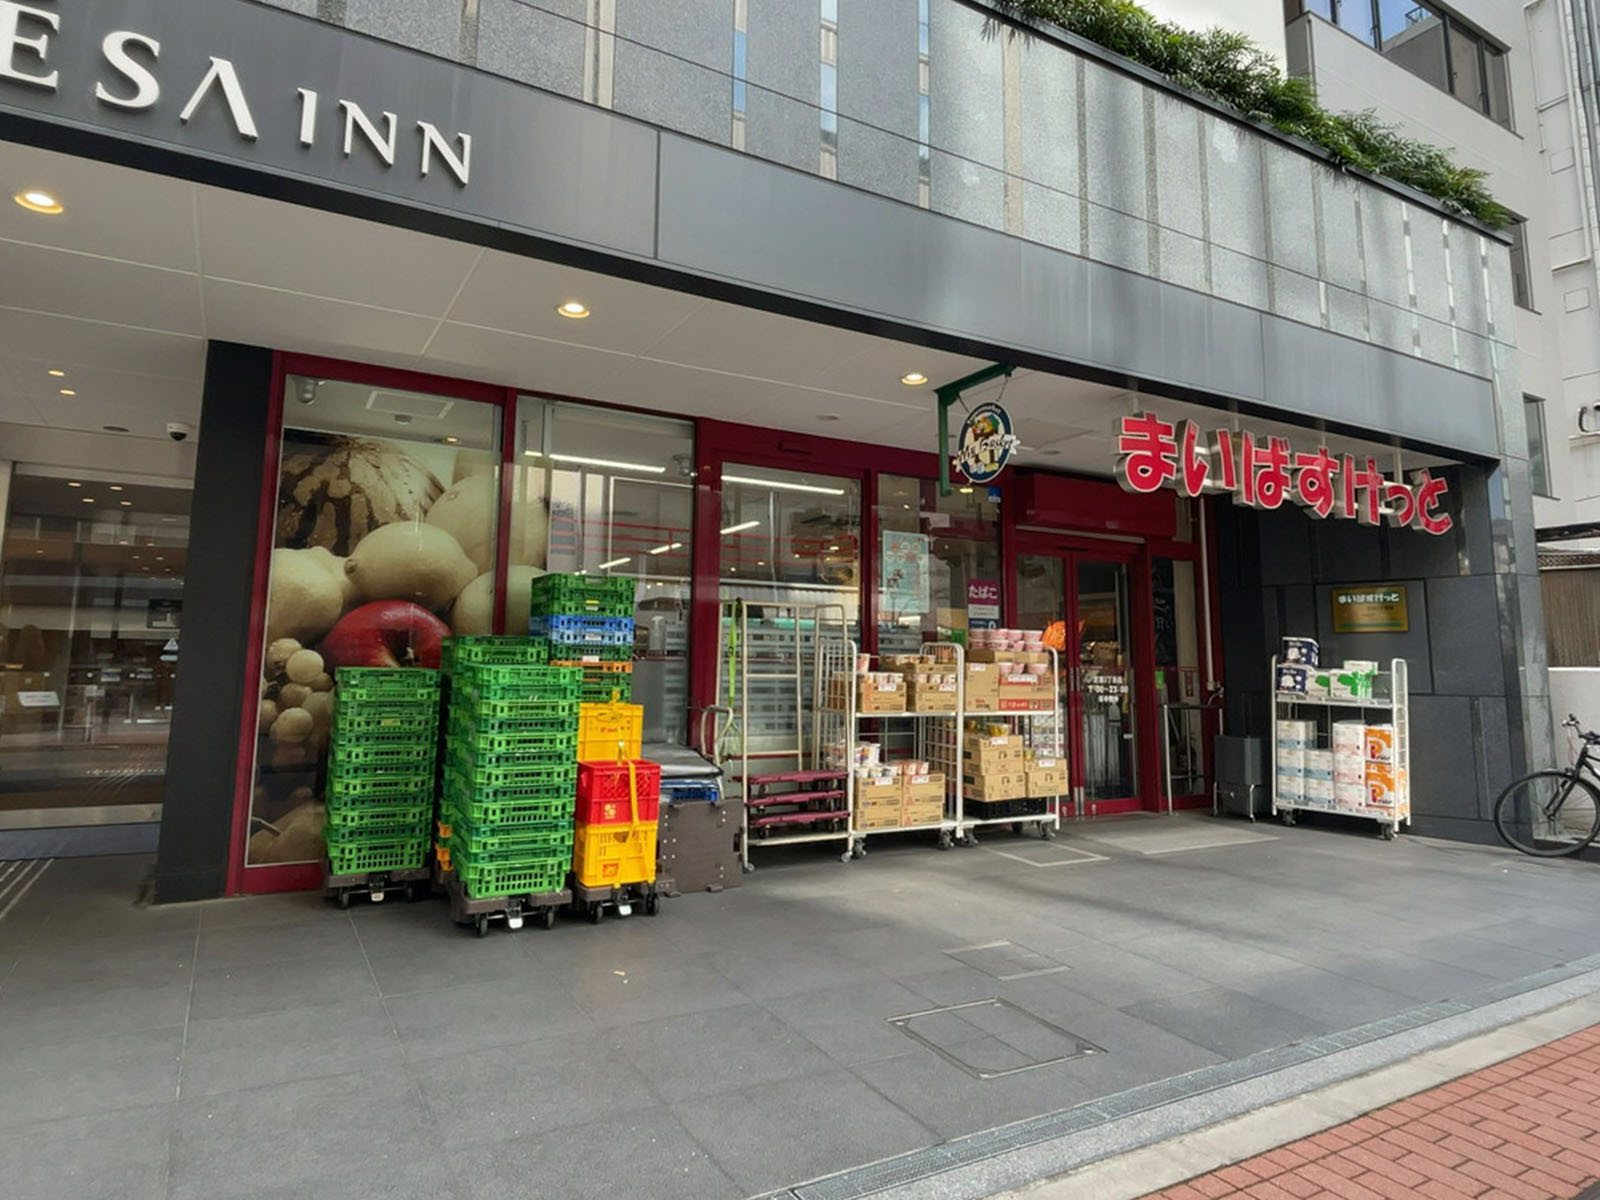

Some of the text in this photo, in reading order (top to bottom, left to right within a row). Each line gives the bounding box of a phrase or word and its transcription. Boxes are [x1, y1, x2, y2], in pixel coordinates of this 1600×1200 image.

[297, 87, 473, 187] INN
[1115, 411, 1454, 536] まいばすけっと
[968, 584, 999, 600] たばこ
